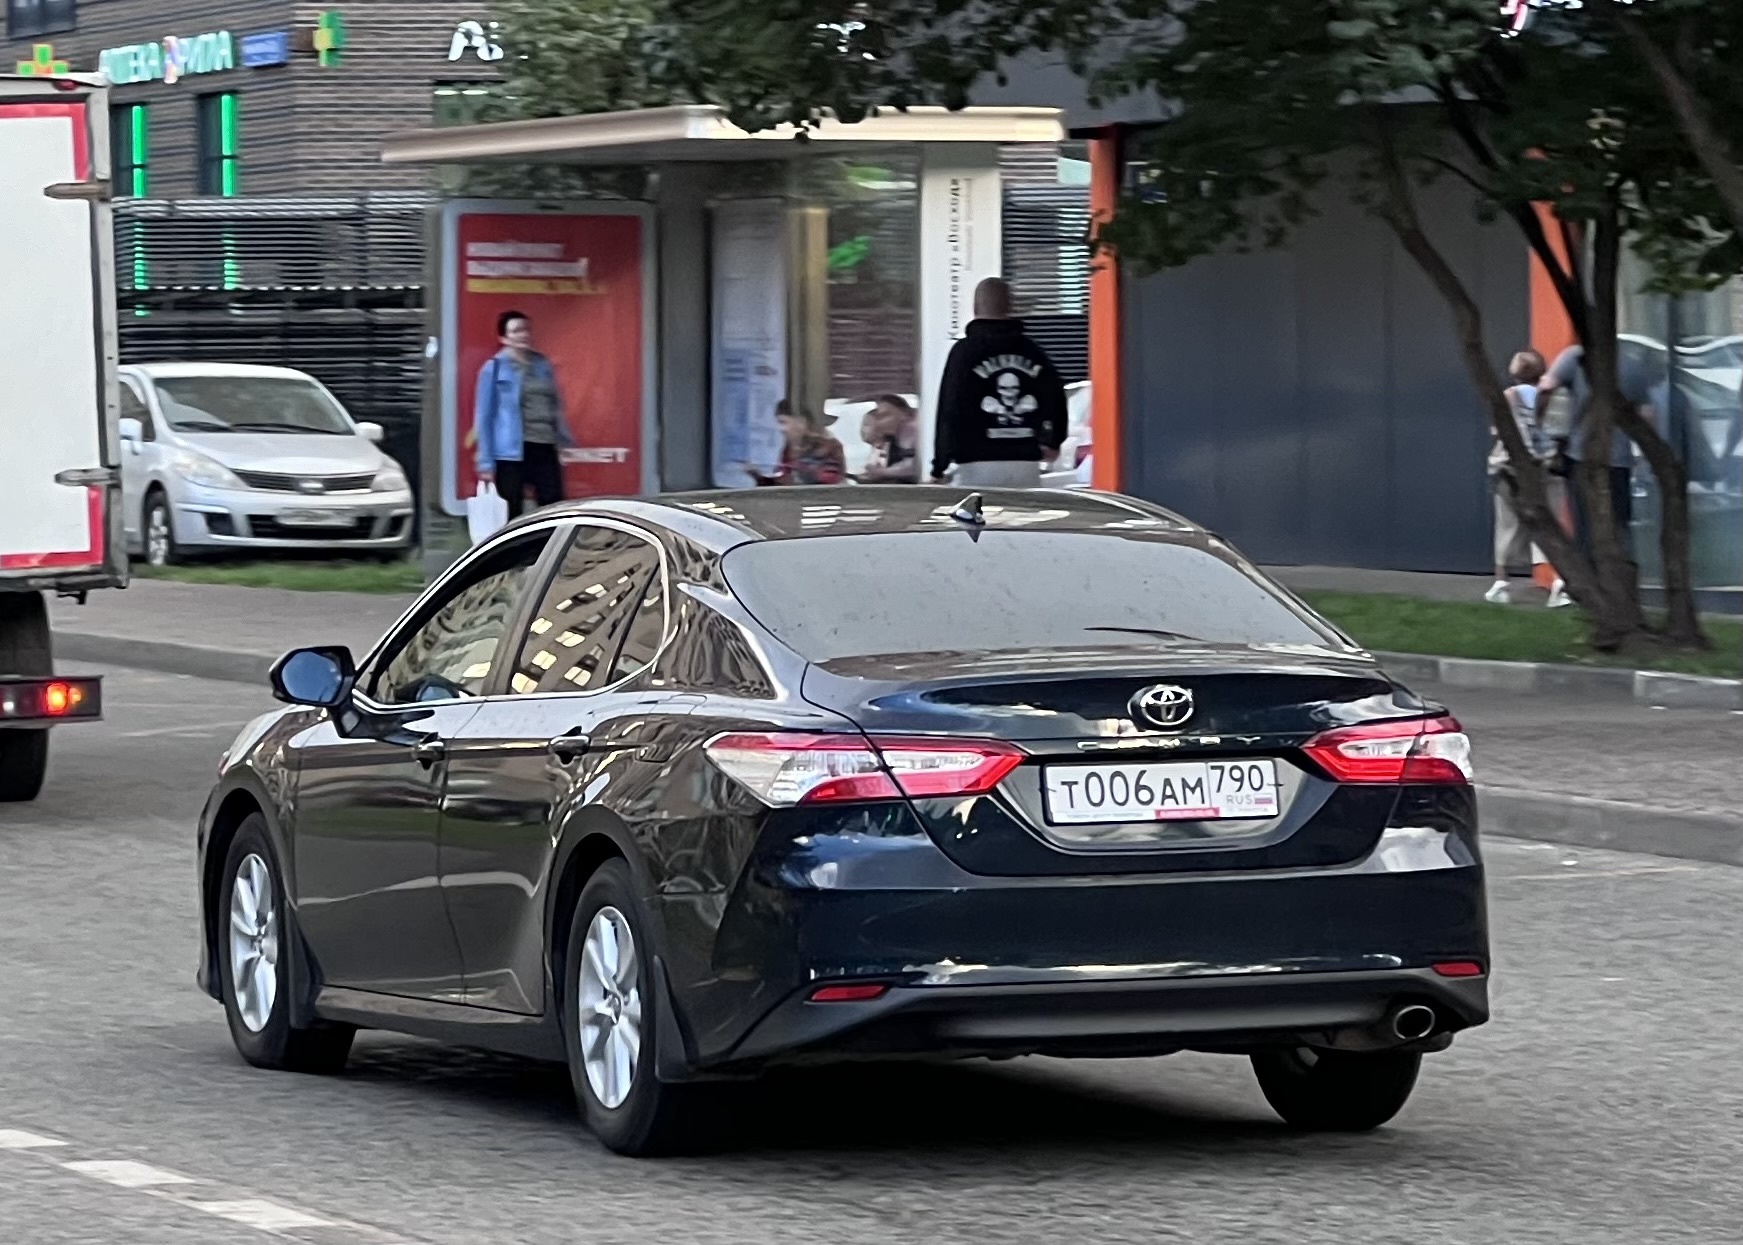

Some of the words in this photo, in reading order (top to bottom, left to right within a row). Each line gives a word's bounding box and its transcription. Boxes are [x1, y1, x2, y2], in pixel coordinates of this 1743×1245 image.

[1060, 770, 1206, 808] Т006АМ
[1210, 764, 1264, 793] 790
[1226, 794, 1253, 805] RUS
